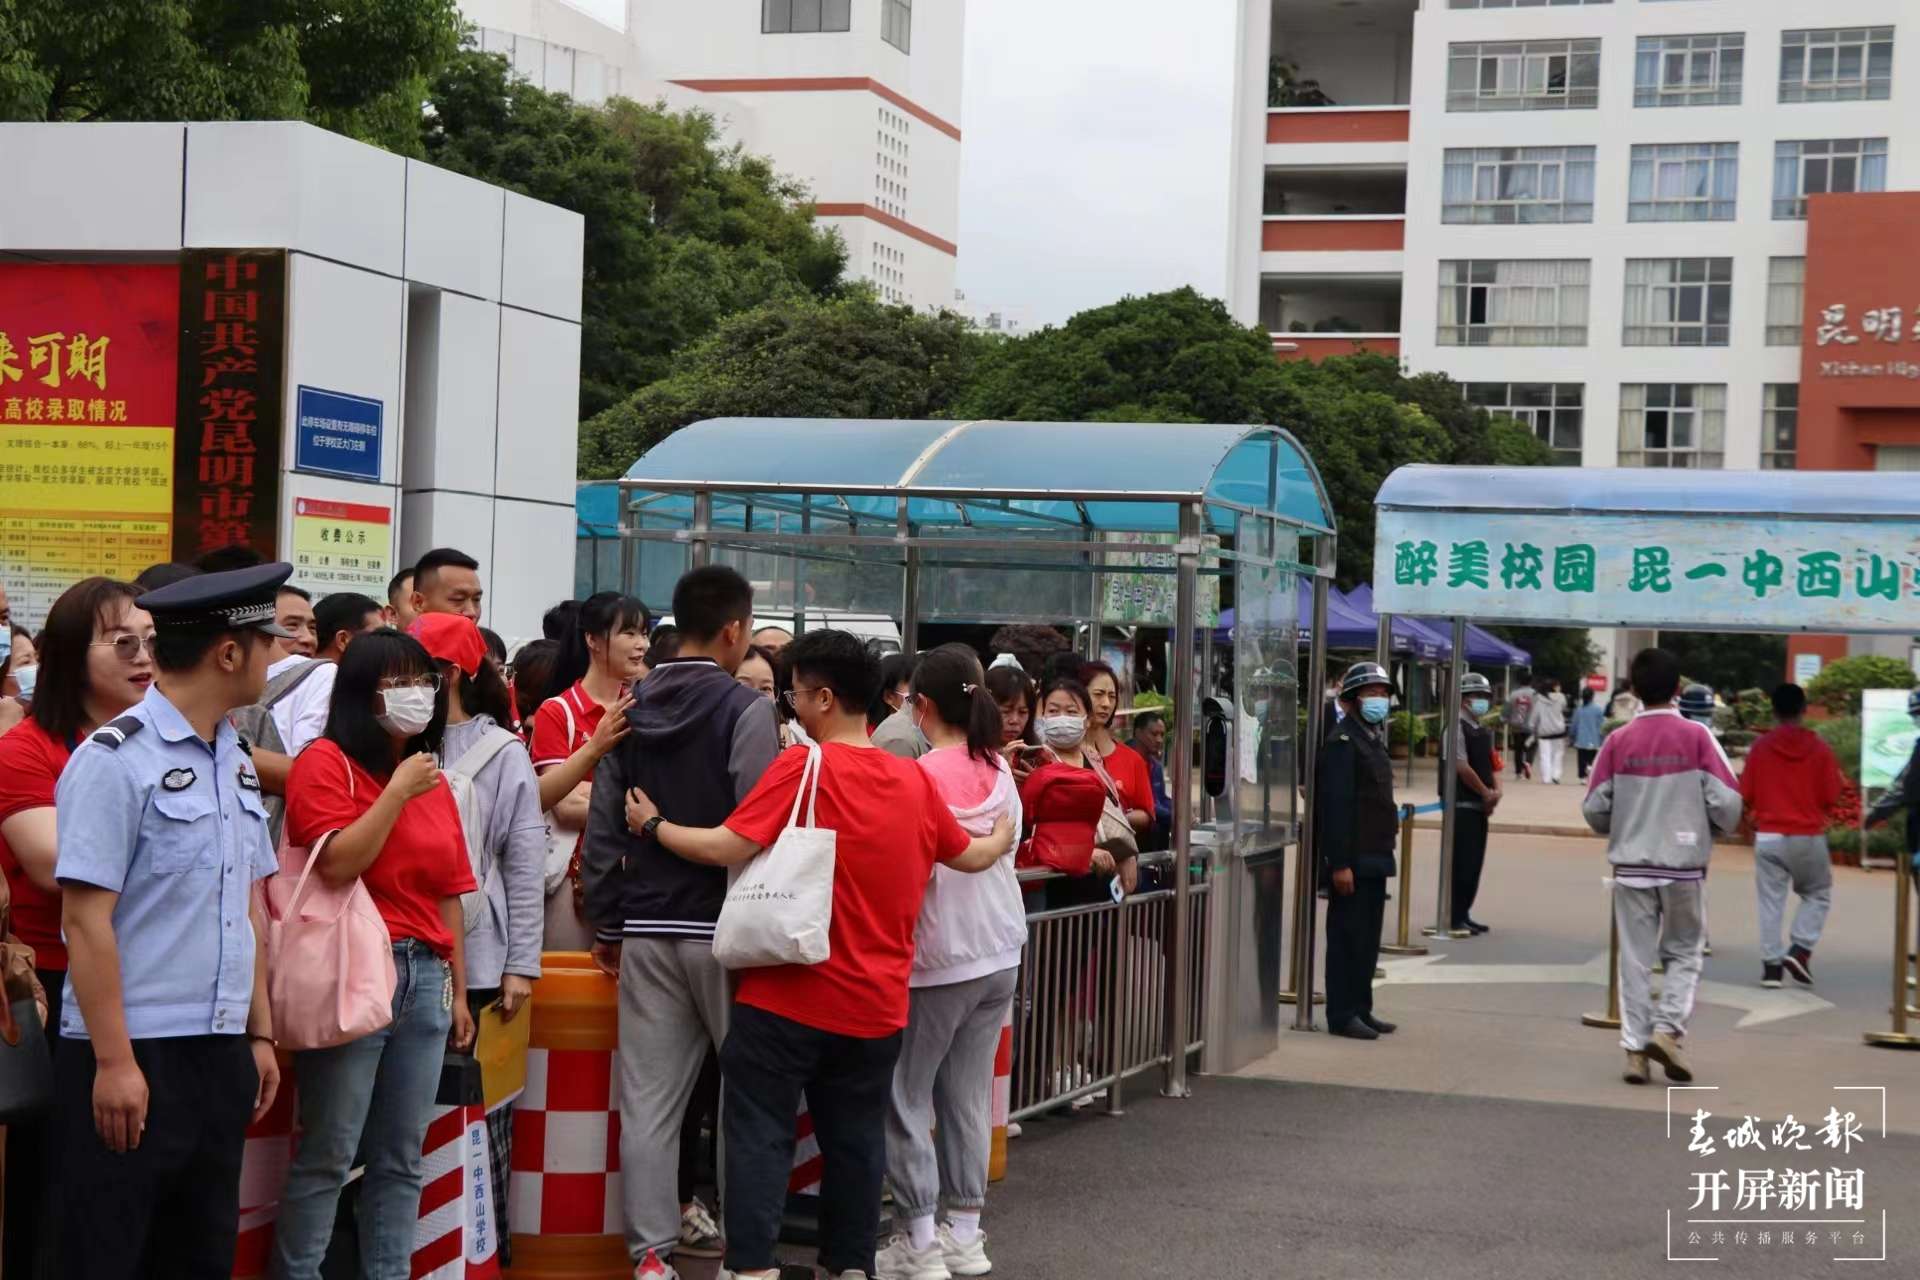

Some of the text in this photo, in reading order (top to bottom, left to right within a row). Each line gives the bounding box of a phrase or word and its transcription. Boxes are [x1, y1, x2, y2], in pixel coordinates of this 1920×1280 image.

[1816, 303, 1920, 347] 昆明
[1395, 540, 1920, 601] 醉美校园 昆一中西山
[471, 1128, 487, 1255] 昆一中西山学校
